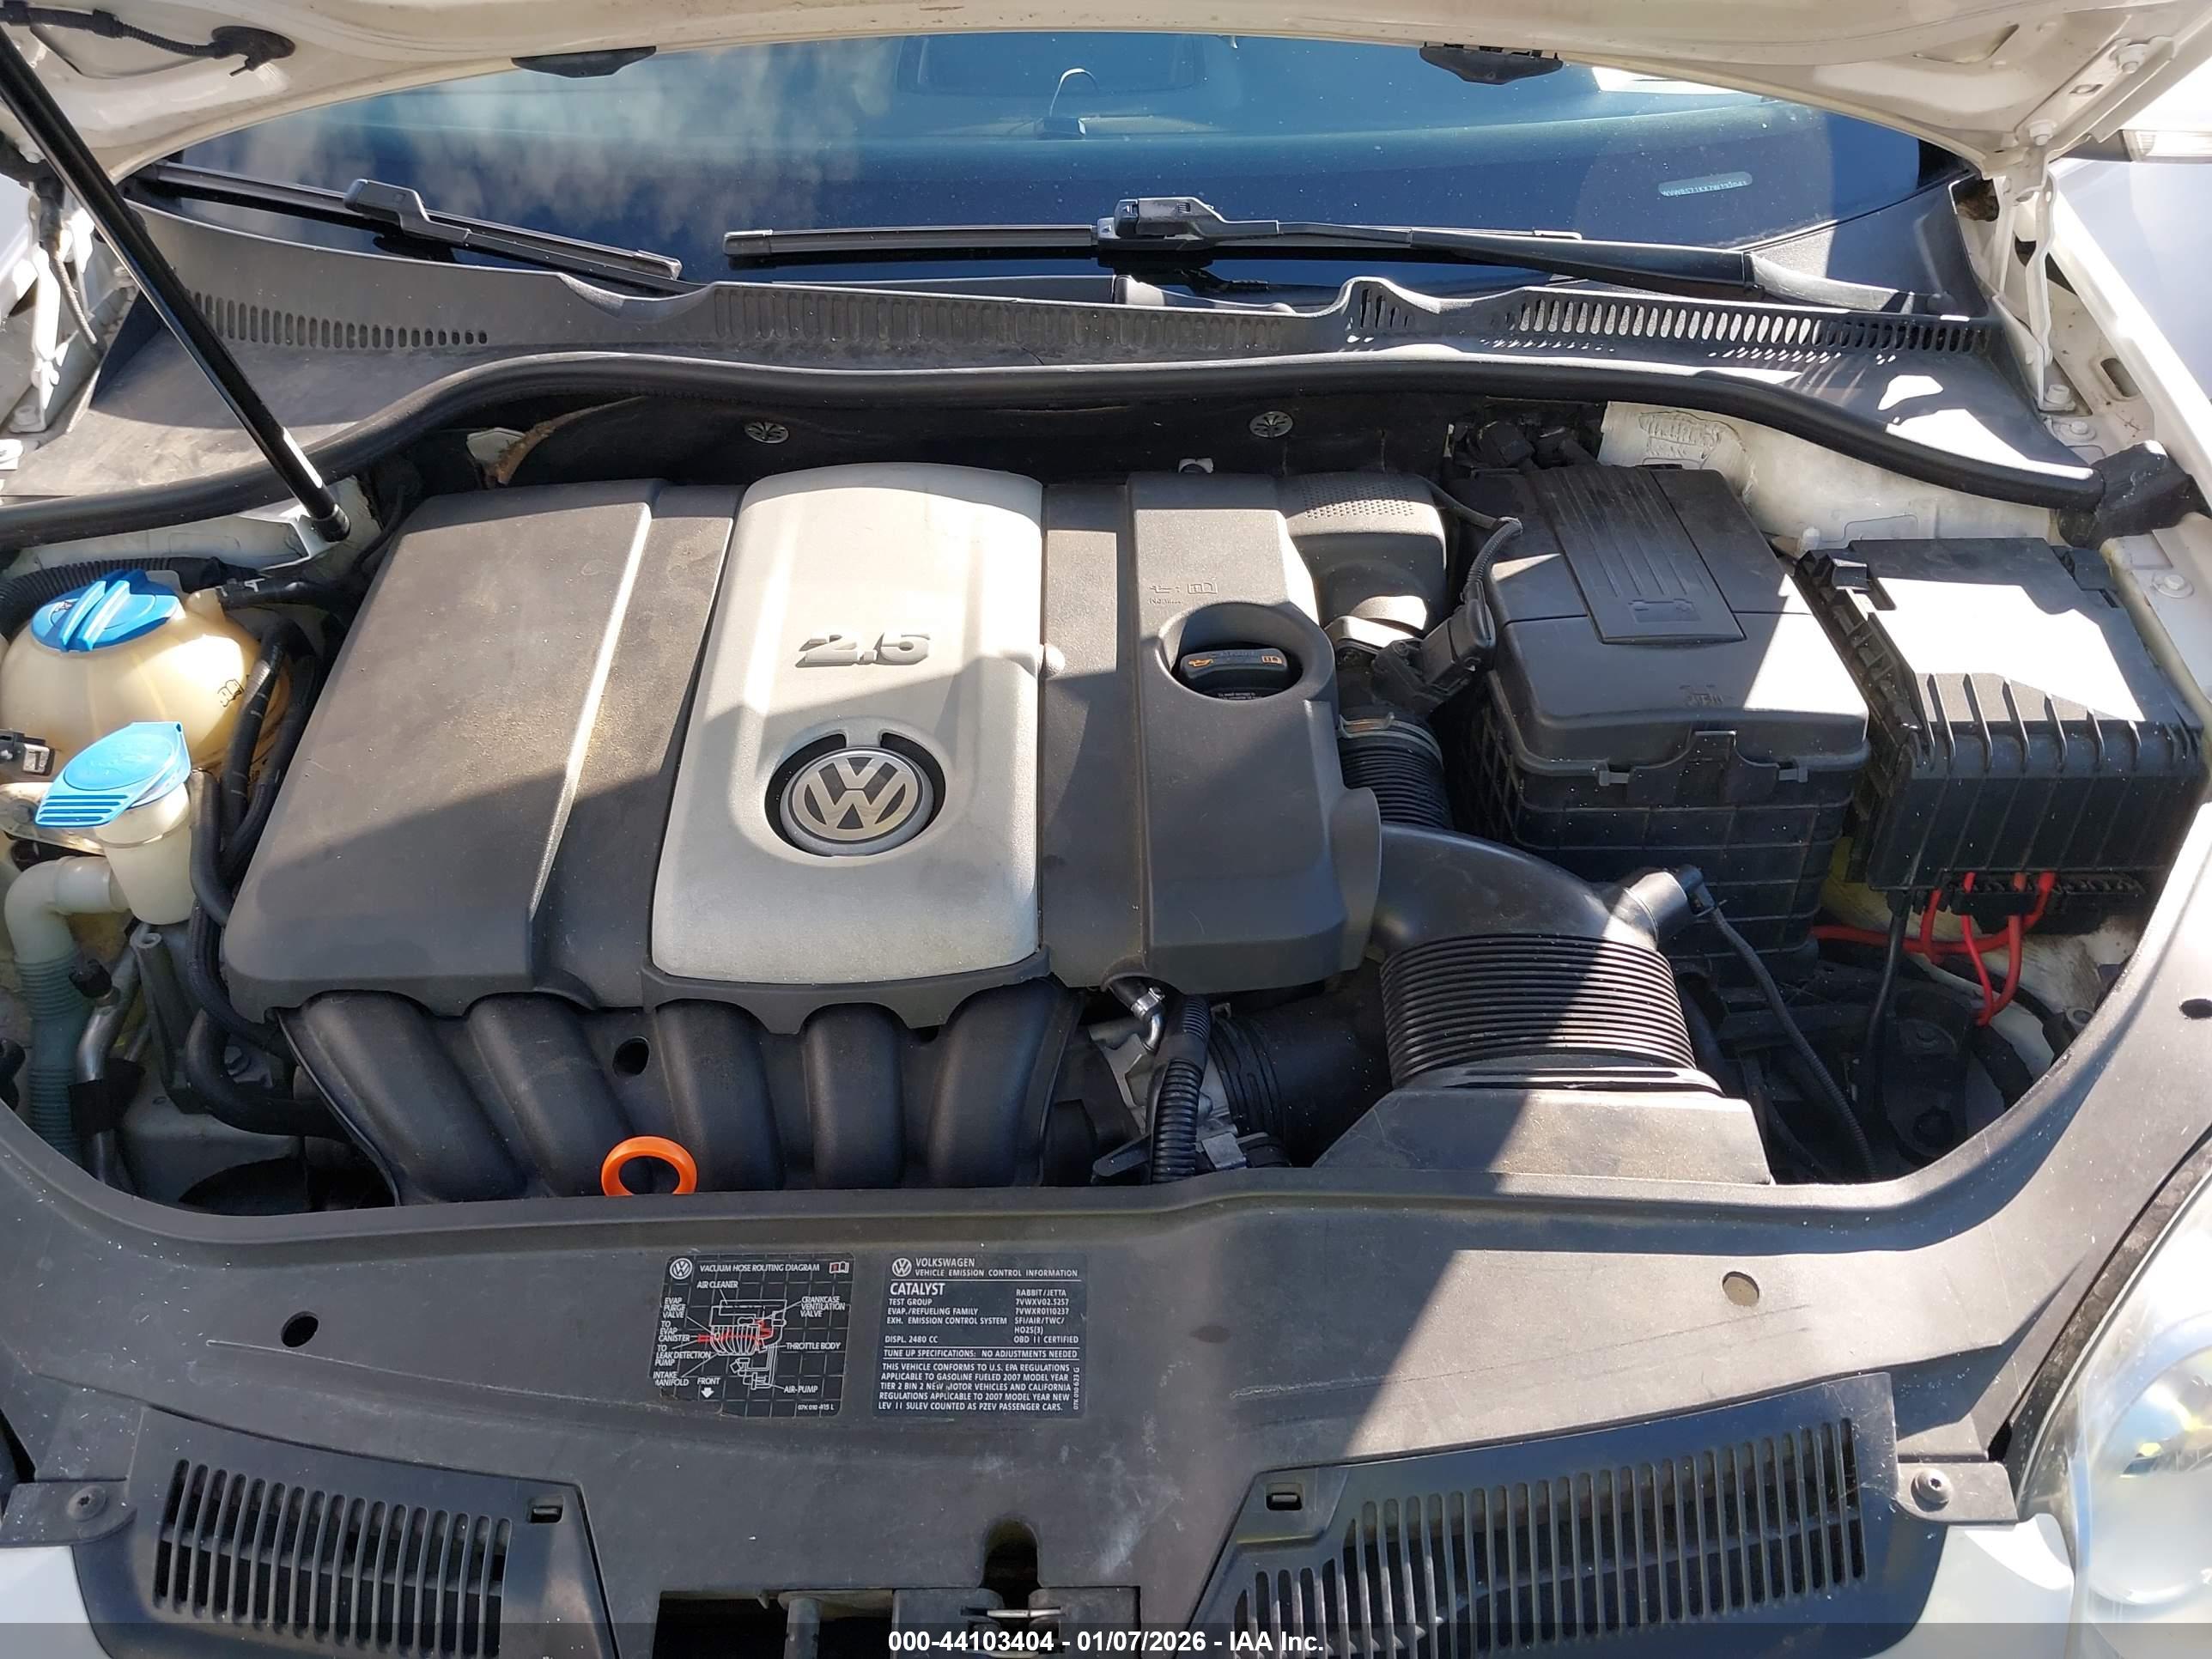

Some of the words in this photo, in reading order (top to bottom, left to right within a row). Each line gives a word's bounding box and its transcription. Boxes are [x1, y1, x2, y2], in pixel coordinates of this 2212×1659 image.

[795, 632, 931, 668] 2.5
[915, 1257, 975, 1267] VOLKSWAGEN
[890, 1283, 945, 1295] CATALYST
